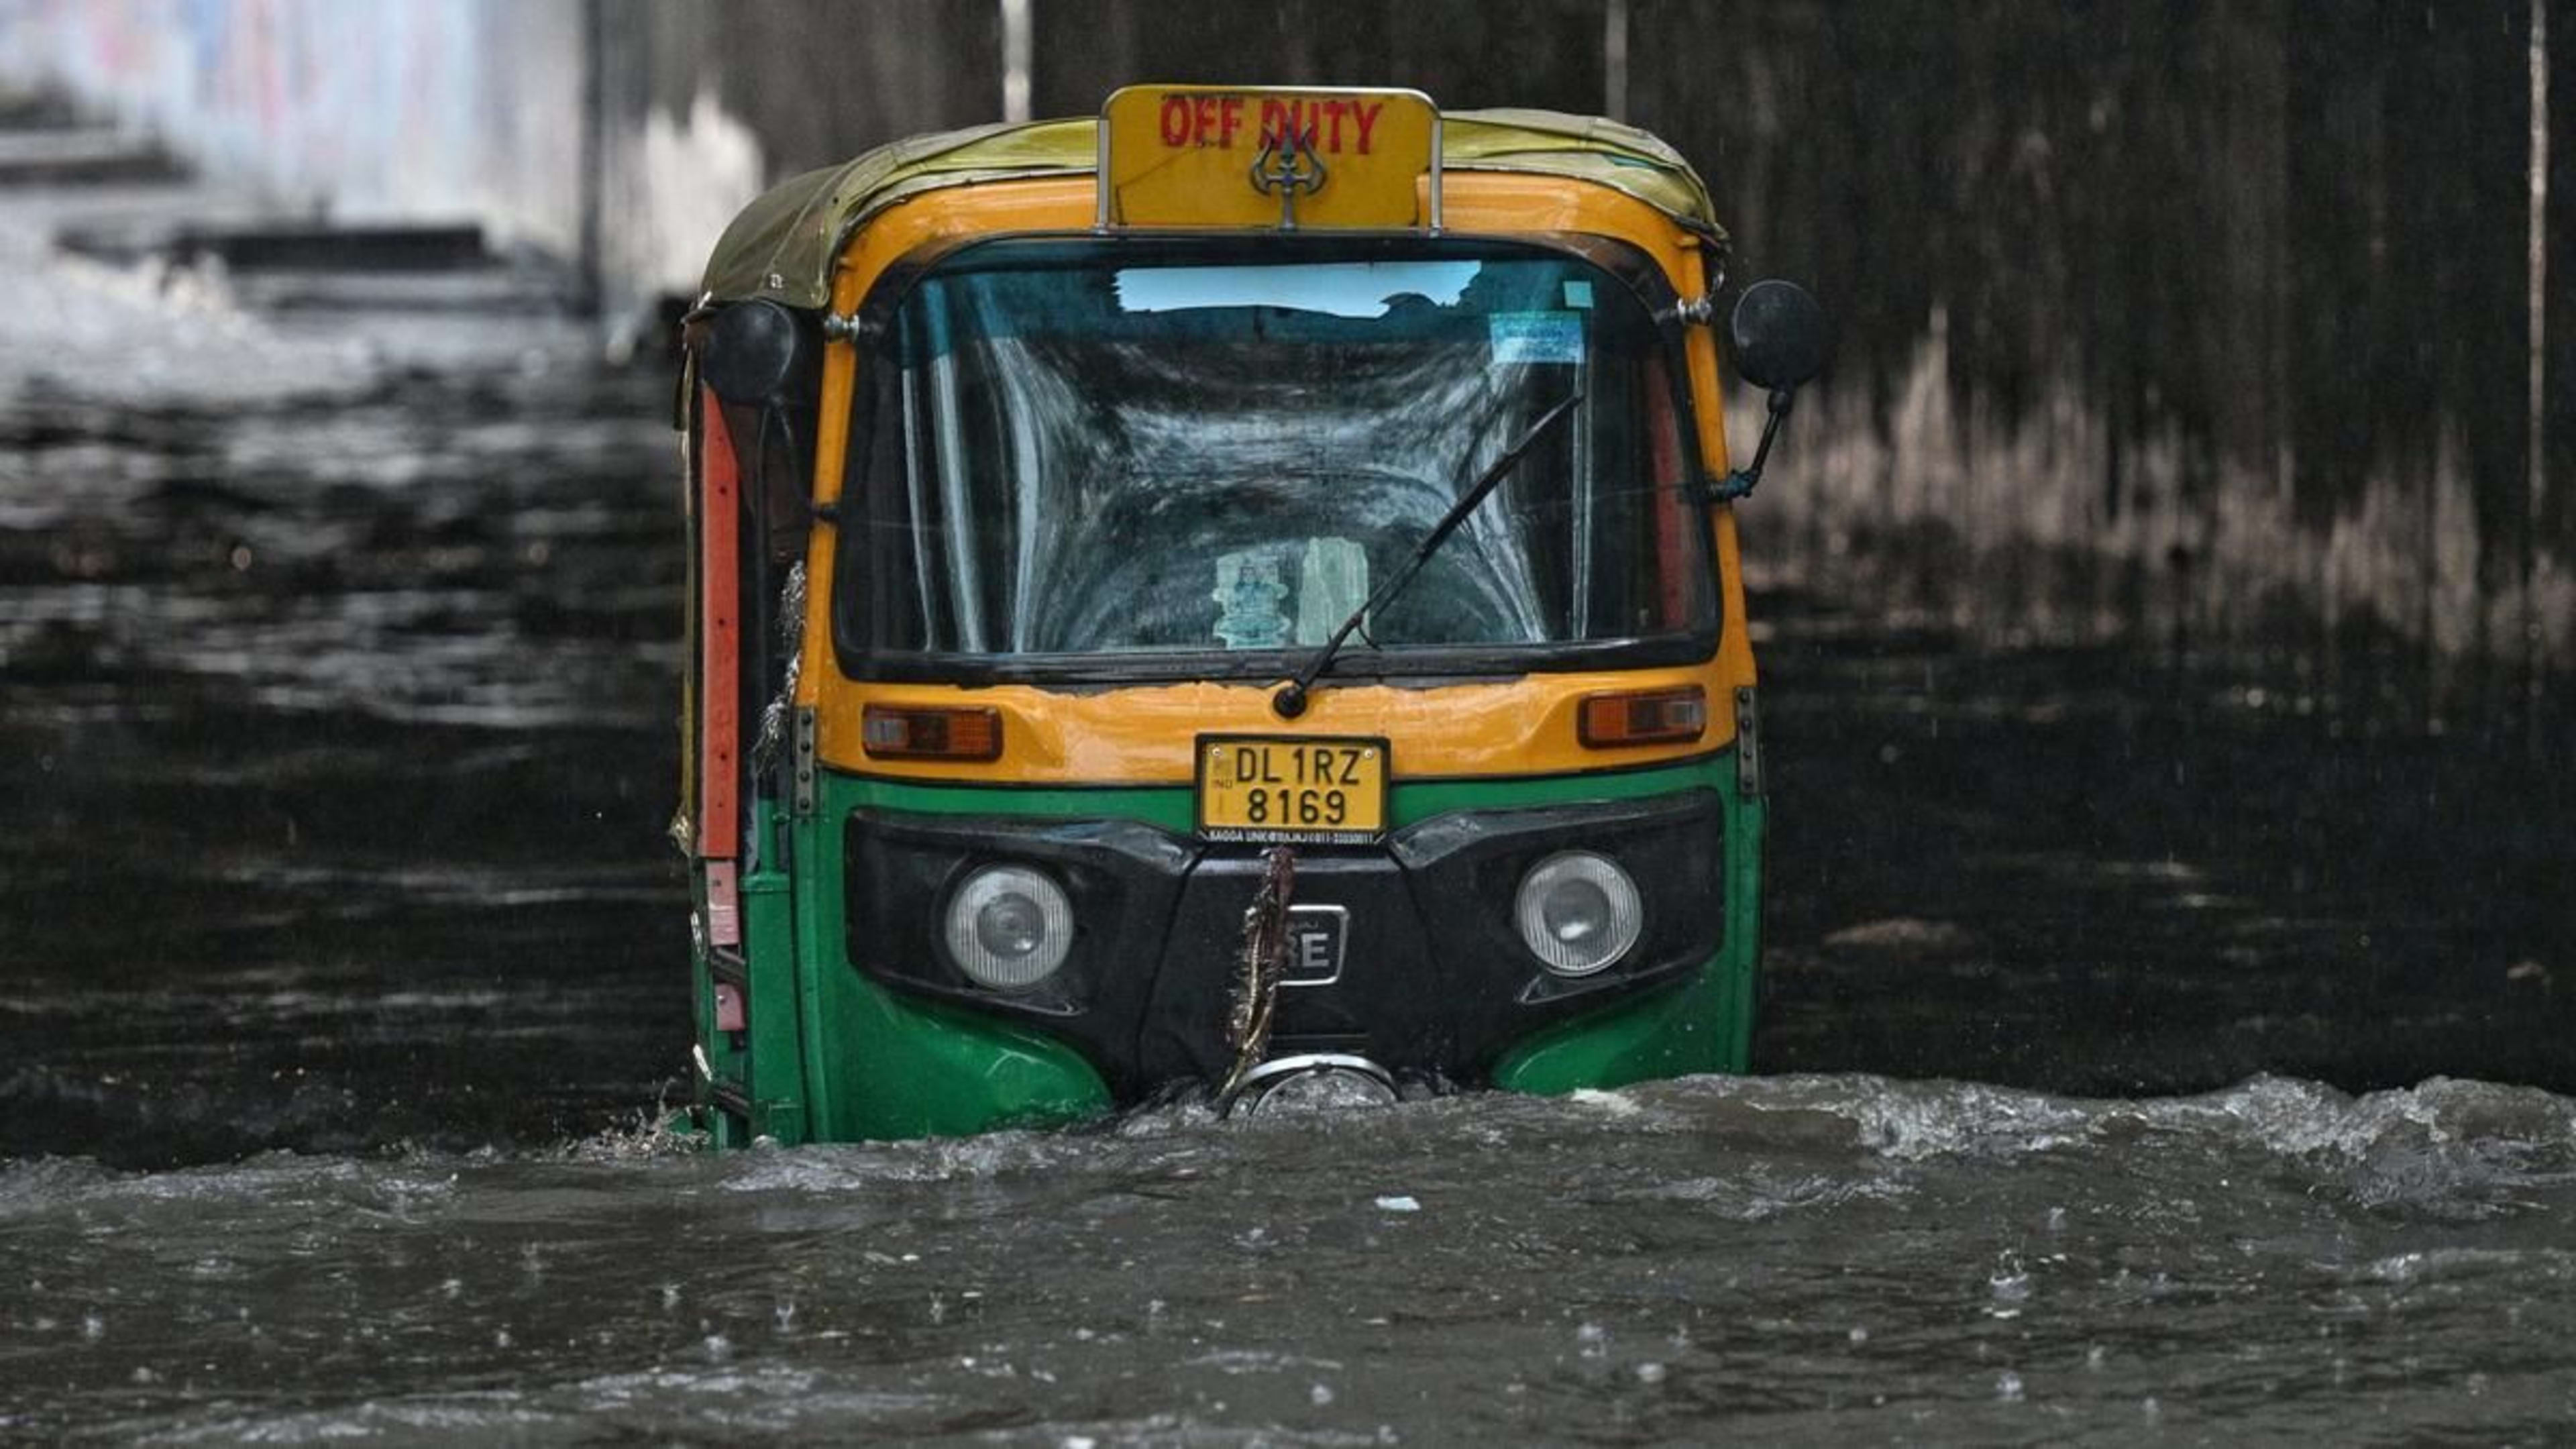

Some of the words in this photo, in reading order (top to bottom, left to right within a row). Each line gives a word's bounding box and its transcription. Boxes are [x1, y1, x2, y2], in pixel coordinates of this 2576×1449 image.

[1161, 97, 1244, 149] OFF
[1259, 99, 1383, 155] DUTY
[1236, 747, 1282, 783] DL
[1293, 748, 1360, 785] 1RZ
[1248, 788, 1344, 824] 8169
